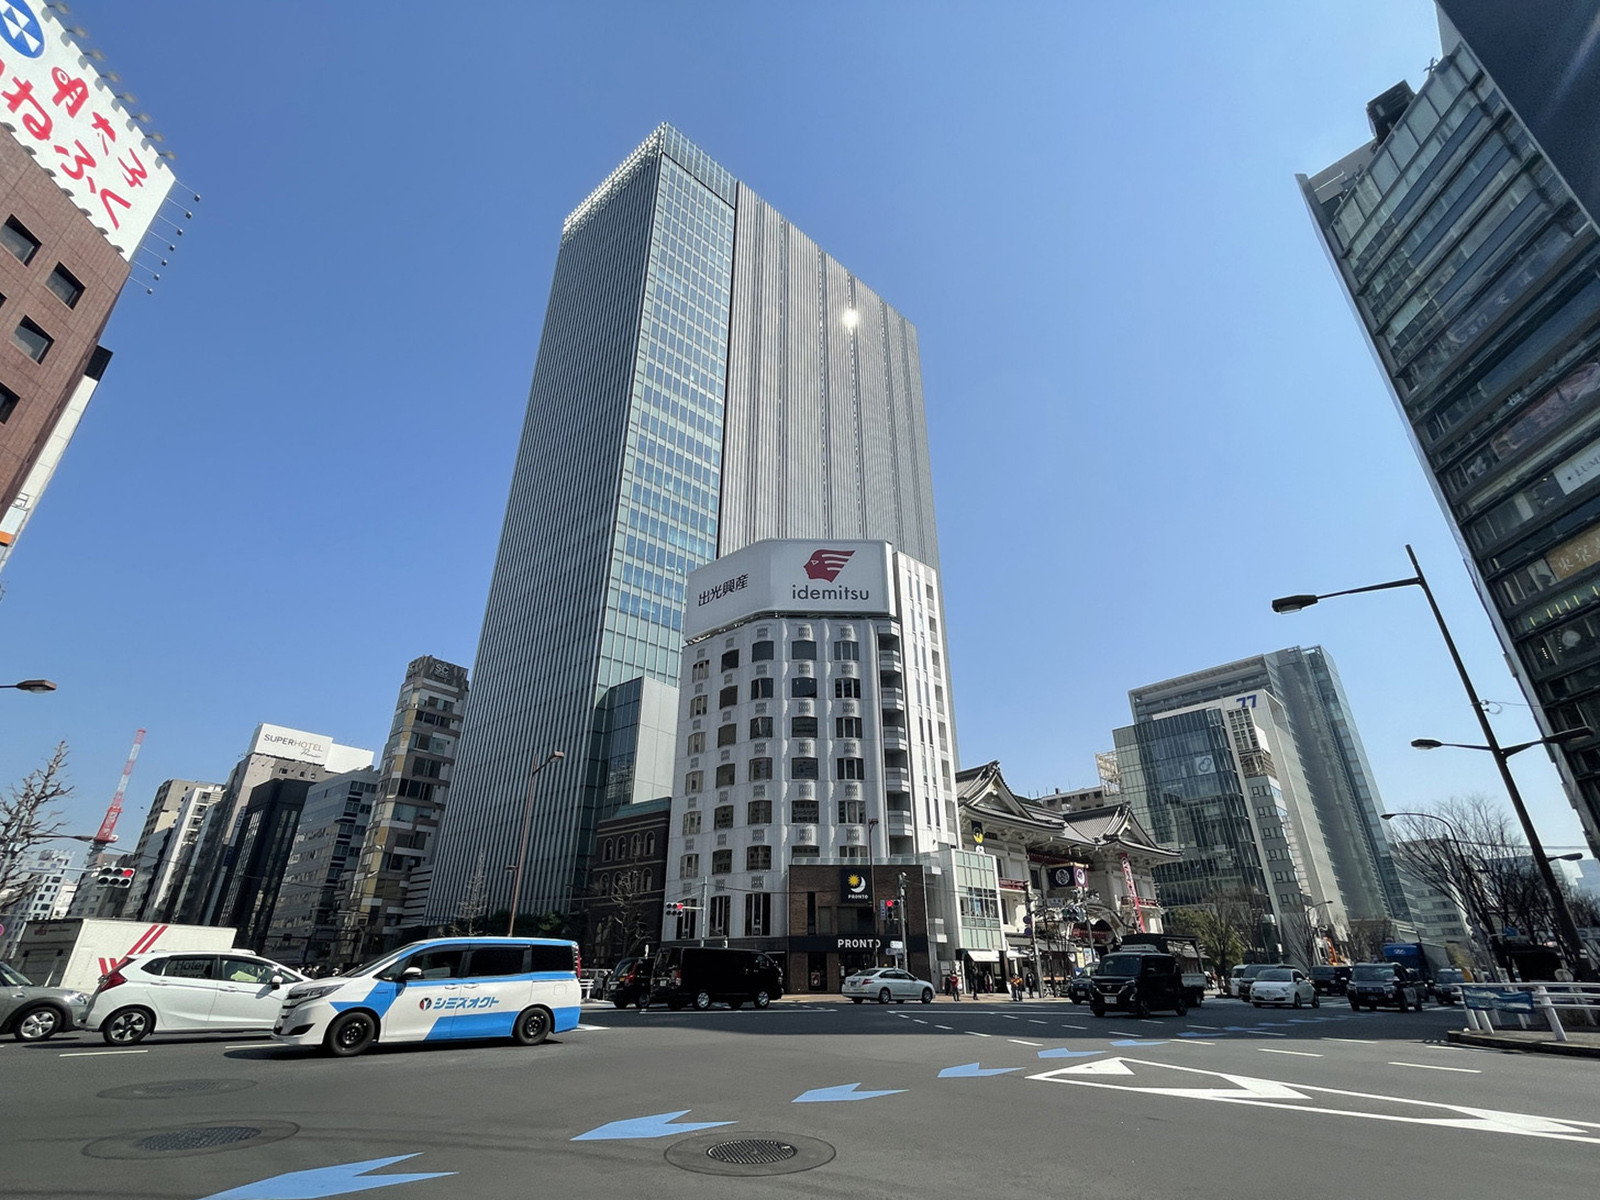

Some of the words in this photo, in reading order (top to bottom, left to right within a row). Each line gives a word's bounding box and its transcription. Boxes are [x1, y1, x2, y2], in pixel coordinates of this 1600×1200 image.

[51, 66, 149, 188] 明太子
[0, 58, 132, 230] ねふく
[698, 573, 749, 607] 出光興産
[792, 584, 870, 601] idemitsu
[1235, 694, 1257, 708] 77
[263, 733, 323, 752] SUPERHOTEL
[433, 996, 500, 1010] シミズオクト
